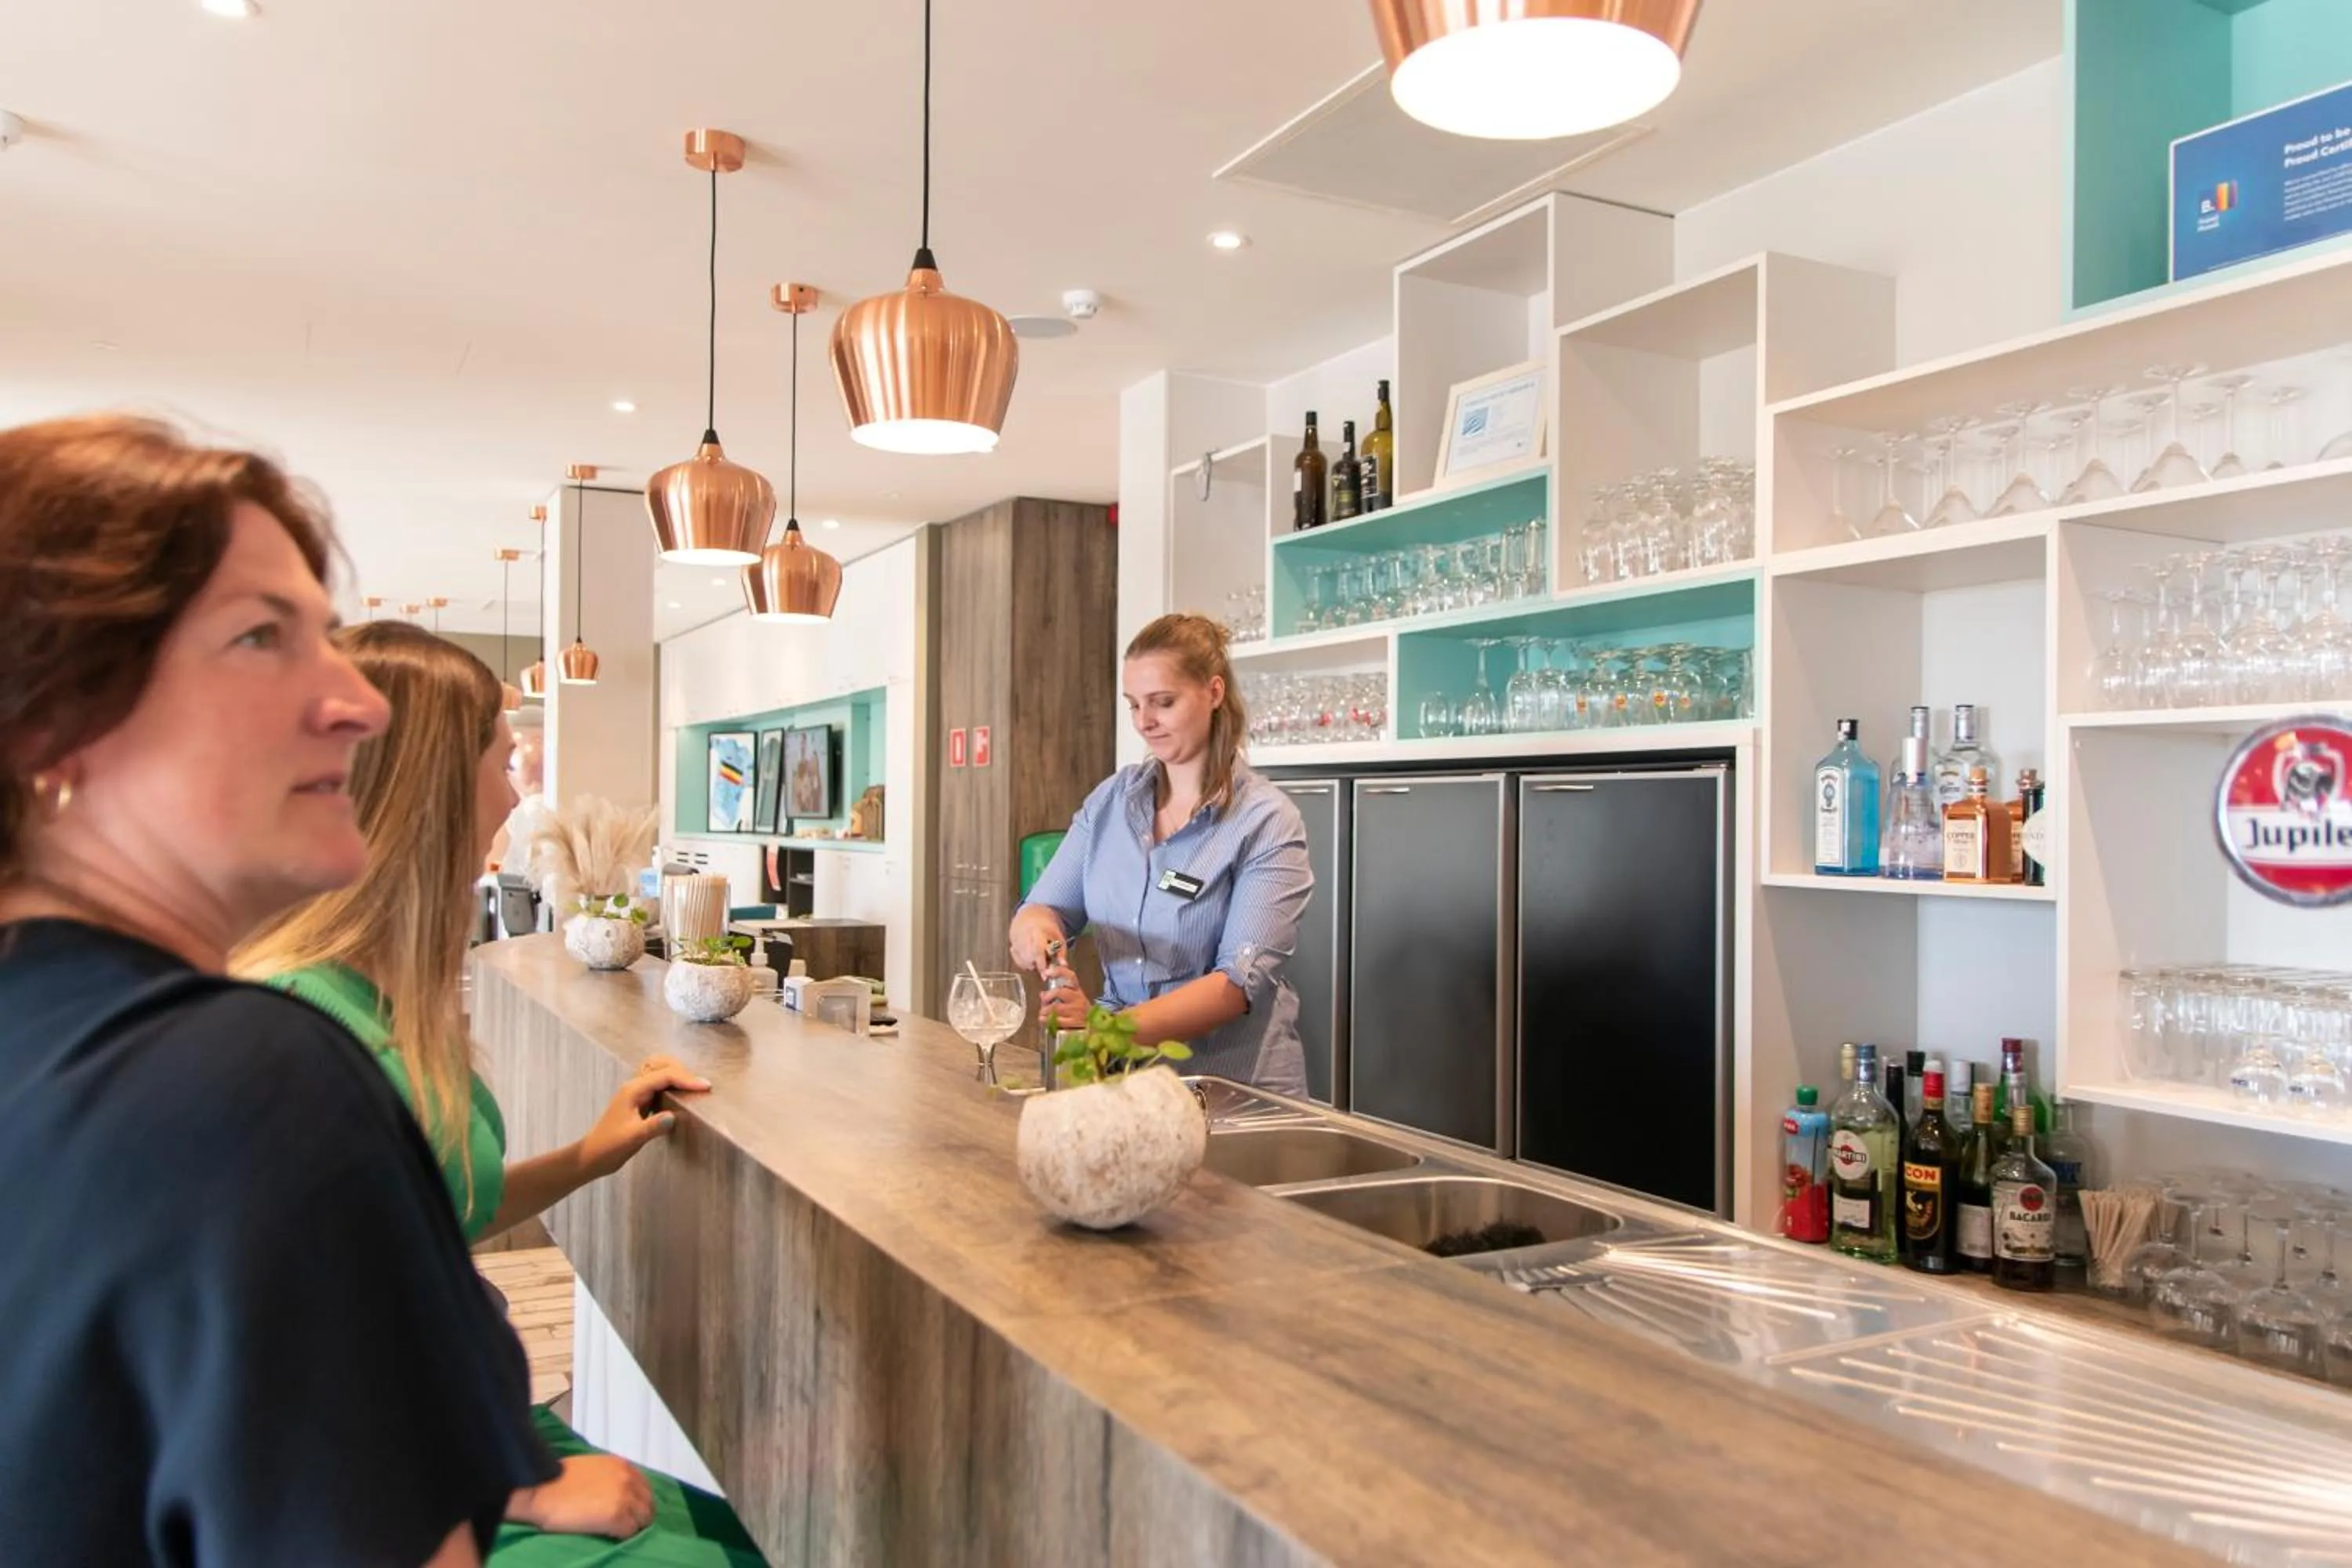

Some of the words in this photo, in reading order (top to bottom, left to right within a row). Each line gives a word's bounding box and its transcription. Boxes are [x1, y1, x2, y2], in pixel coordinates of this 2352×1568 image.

[2284, 135, 2318, 154] Proud
[2320, 132, 2334, 143] to
[2335, 126, 2351, 139] be
[2284, 147, 2318, 169] Proud
